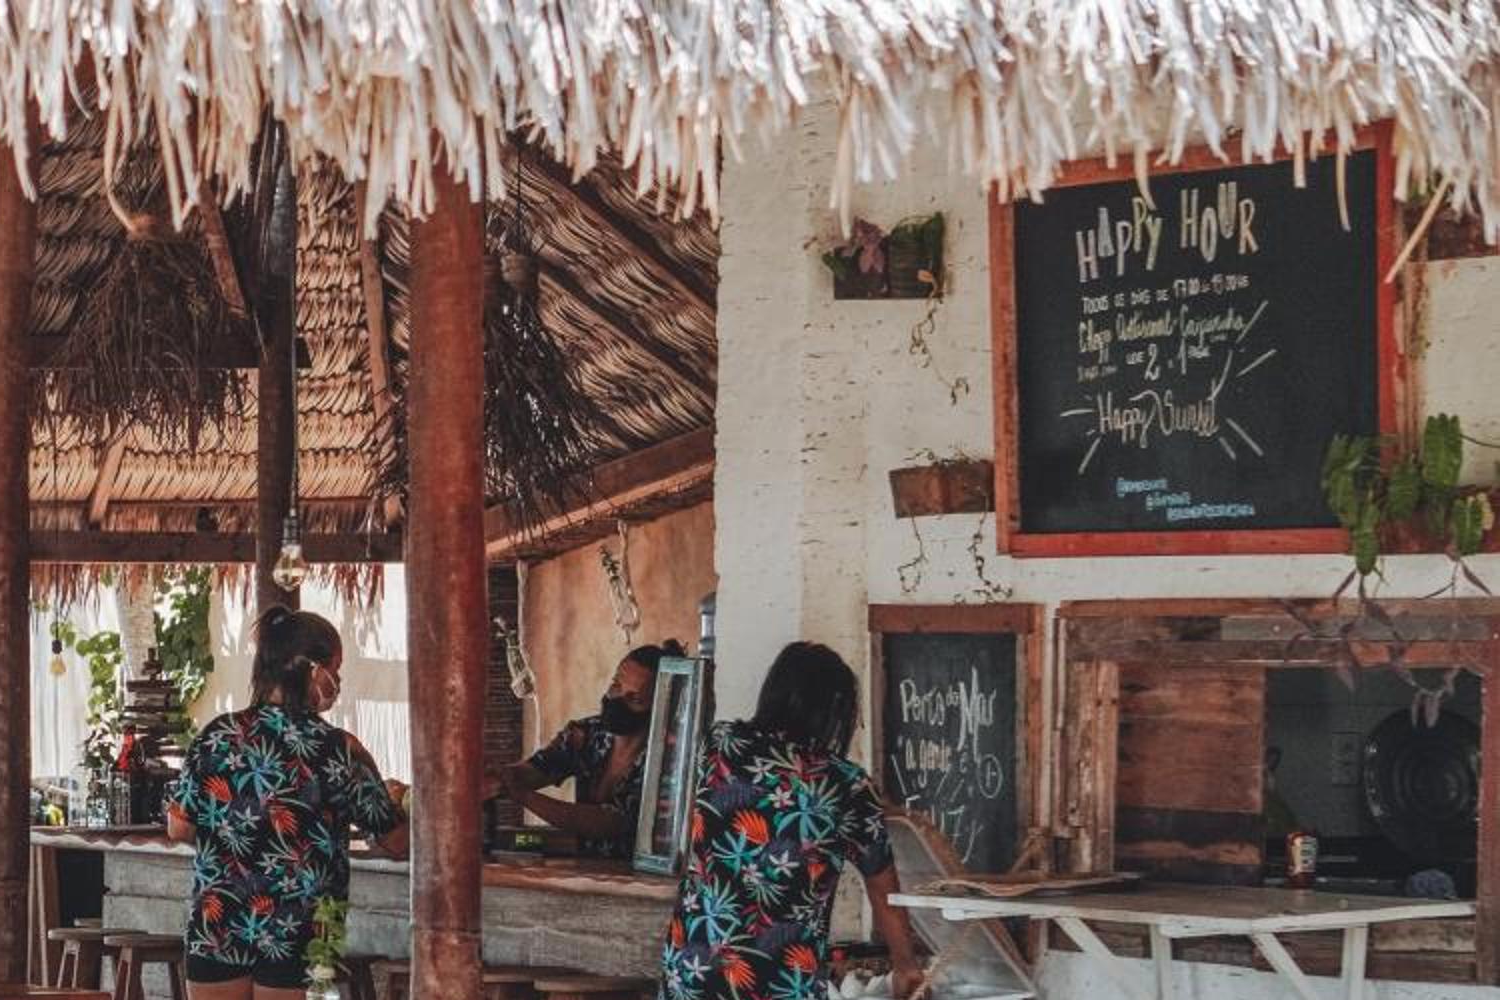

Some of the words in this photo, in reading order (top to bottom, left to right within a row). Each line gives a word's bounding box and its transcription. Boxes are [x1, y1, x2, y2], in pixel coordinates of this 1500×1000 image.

[1076, 197, 1162, 282] HAPPY
[1180, 182, 1259, 263] HOUR
[1097, 391, 1156, 448] Happy
[1153, 375, 1223, 437] Sunset
